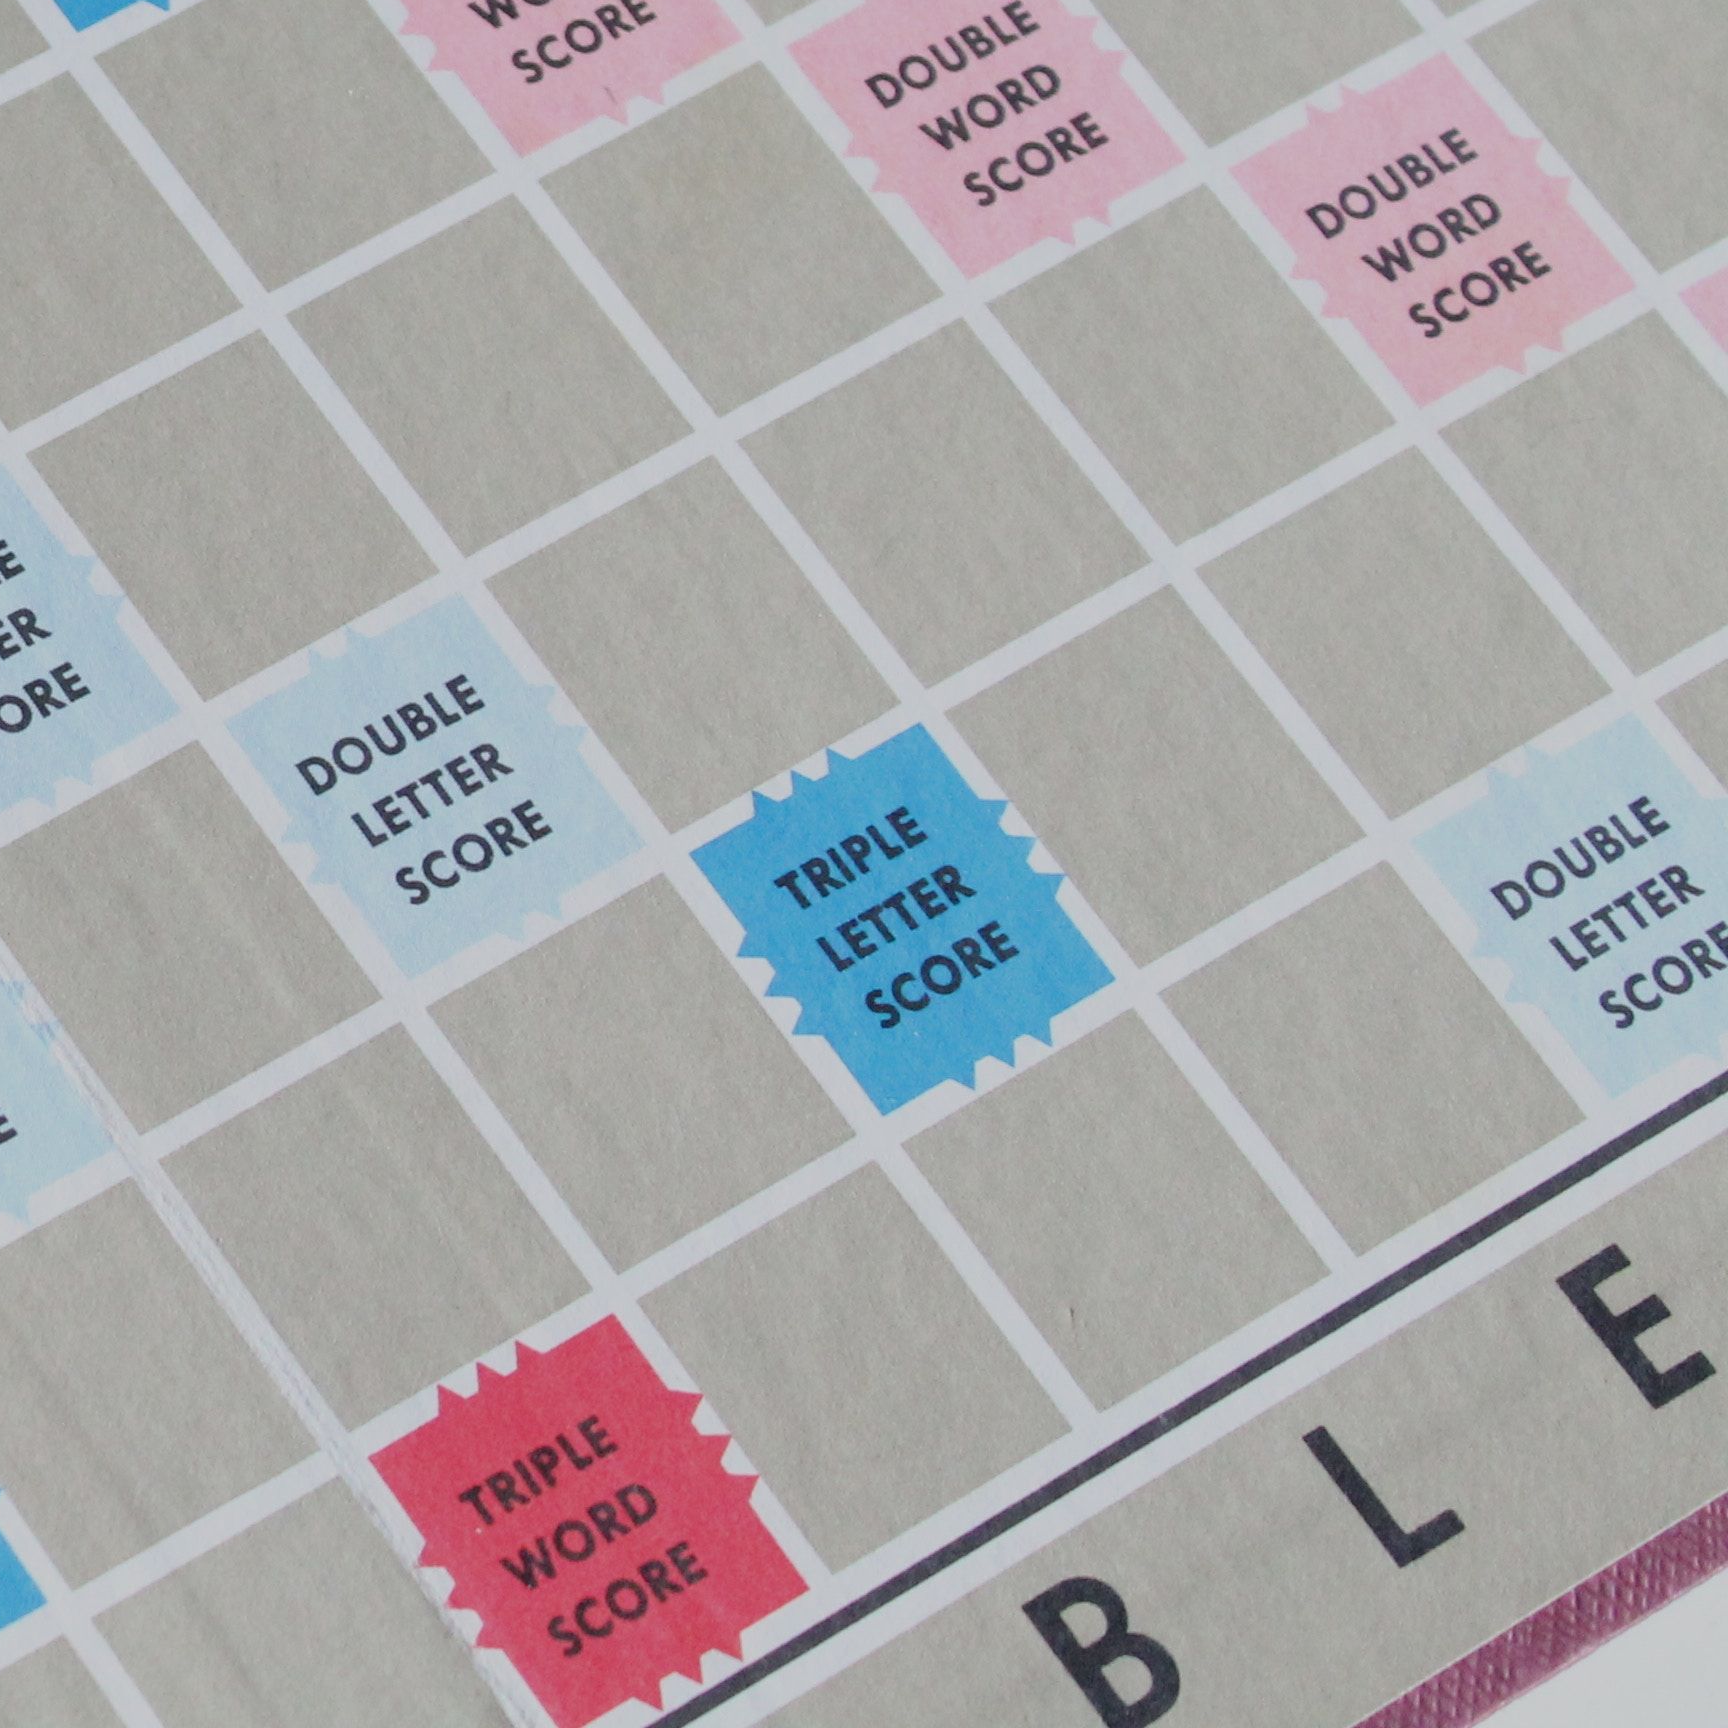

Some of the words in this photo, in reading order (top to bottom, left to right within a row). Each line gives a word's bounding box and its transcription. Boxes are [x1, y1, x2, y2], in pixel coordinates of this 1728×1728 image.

[917, 63, 1062, 152] WORD
[962, 110, 1110, 208] SCORE
[1304, 126, 1480, 241] DOUBLE
[1359, 192, 1503, 284] WORD
[1407, 239, 1553, 340] SCORE
[293, 672, 487, 798] DOUBLE
[349, 742, 516, 849] LETTER
[394, 798, 554, 907] SCORE
[772, 805, 930, 911] TRIPLE
[1488, 794, 1672, 922] DOUBLE
[815, 863, 978, 974] LETTER
[1548, 863, 1707, 973] LETTER
[863, 919, 1021, 1030] SCORE
[1598, 920, 1728, 1031] SCORE
[457, 1414, 620, 1527] TRIPLE
[498, 1482, 659, 1591] WORD
[546, 1540, 709, 1659] SCORE
